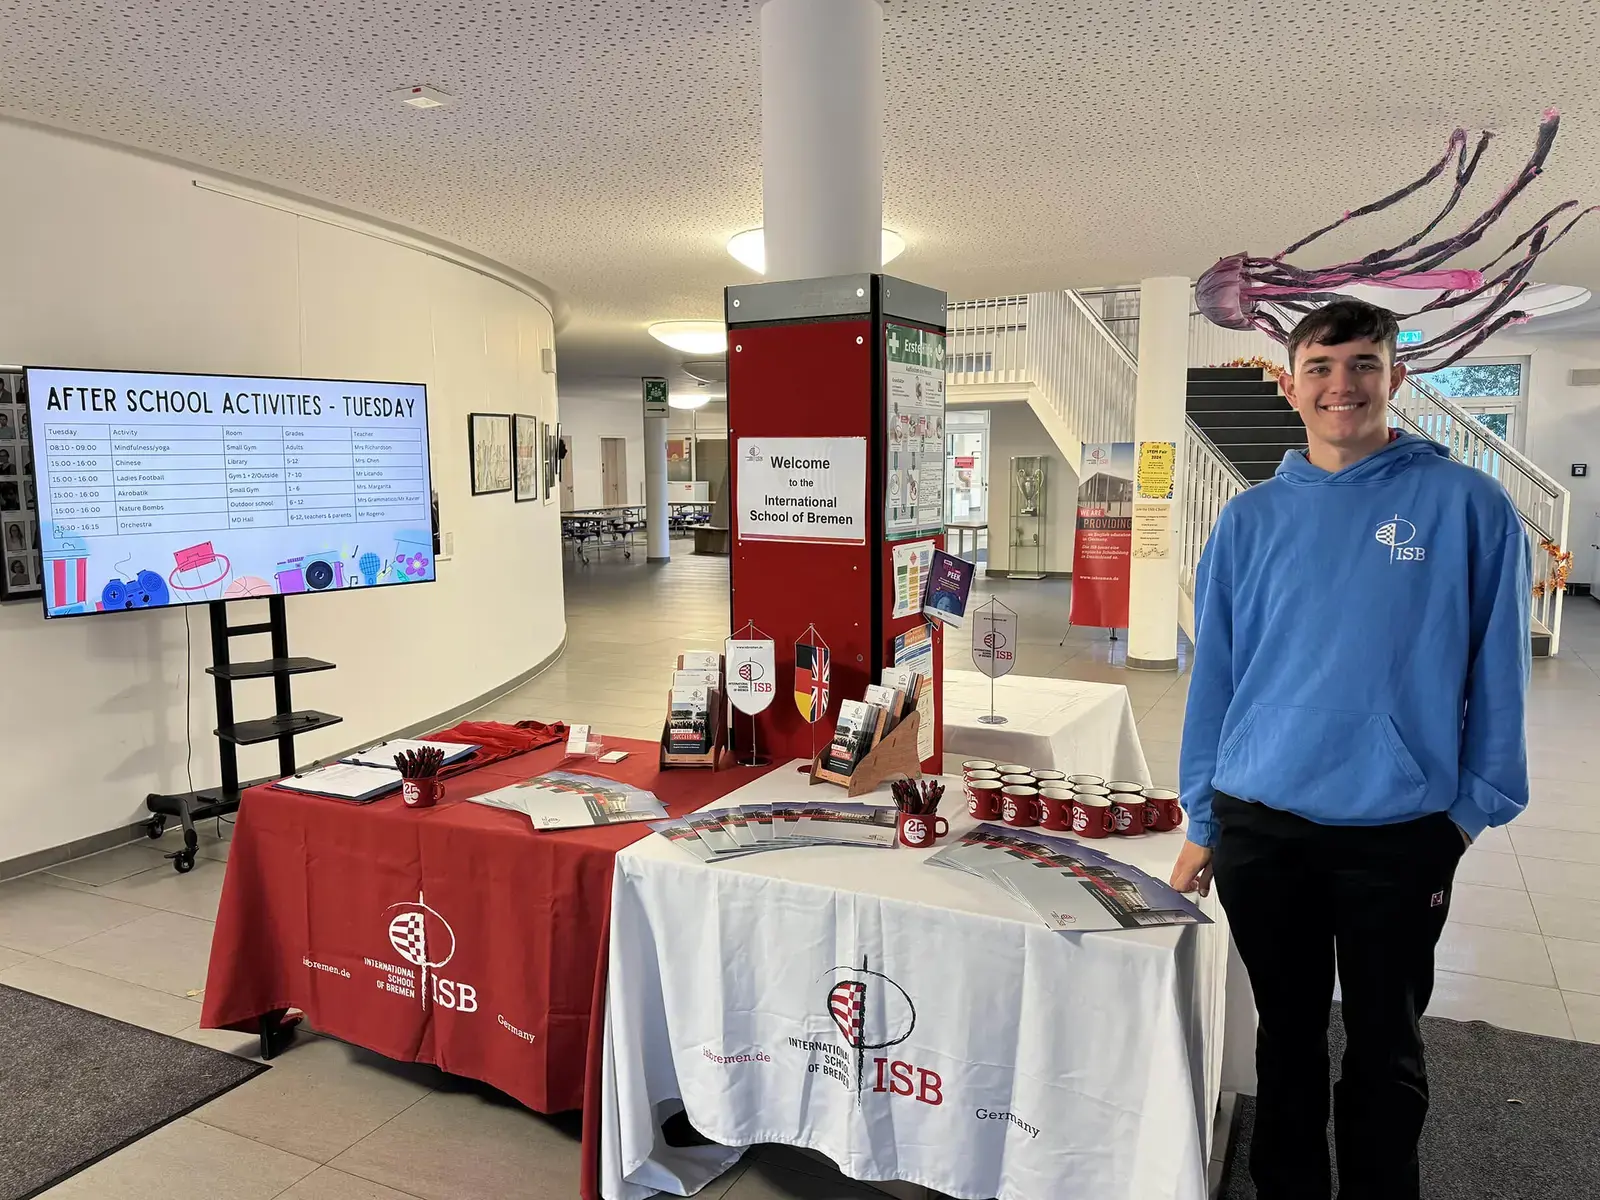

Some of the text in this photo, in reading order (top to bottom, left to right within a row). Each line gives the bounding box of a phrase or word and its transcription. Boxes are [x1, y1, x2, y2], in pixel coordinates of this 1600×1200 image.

[47, 386, 117, 412] AFTER
[127, 389, 213, 414] SCHOOL
[222, 392, 322, 416] ACTIVITIES
[342, 395, 415, 418] TUESDAY
[48, 428, 77, 437] Tuesday
[113, 429, 138, 437] Activity
[114, 444, 170, 452] Mindfulness/yoga
[770, 456, 830, 469] Welcome
[789, 478, 814, 487] to the
[765, 494, 837, 508] International
[750, 509, 853, 525] School of Bremen
[1080, 509, 1102, 517] WE ARE
[1396, 547, 1426, 561] ISB
[947, 570, 961, 581] PEEK
[995, 650, 1013, 660] ISB
[753, 682, 772, 692] ISB
[404, 783, 420, 800] 25
[1003, 798, 1018, 818] 25
[1072, 806, 1089, 828] 25
[1113, 806, 1133, 827] 25
[908, 820, 927, 840] 25
[363, 957, 415, 978] INTERNATIONAL
[376, 979, 415, 998] OF BREMEN
[387, 973, 415, 988] SCHOOL
[430, 973, 478, 1013] ISB
[497, 1014, 536, 1044] Germany
[702, 1045, 771, 1064] isbremen.de
[808, 1063, 820, 1073] OF
[872, 1057, 944, 1106] ISB
[975, 1108, 1041, 1139] Germany
